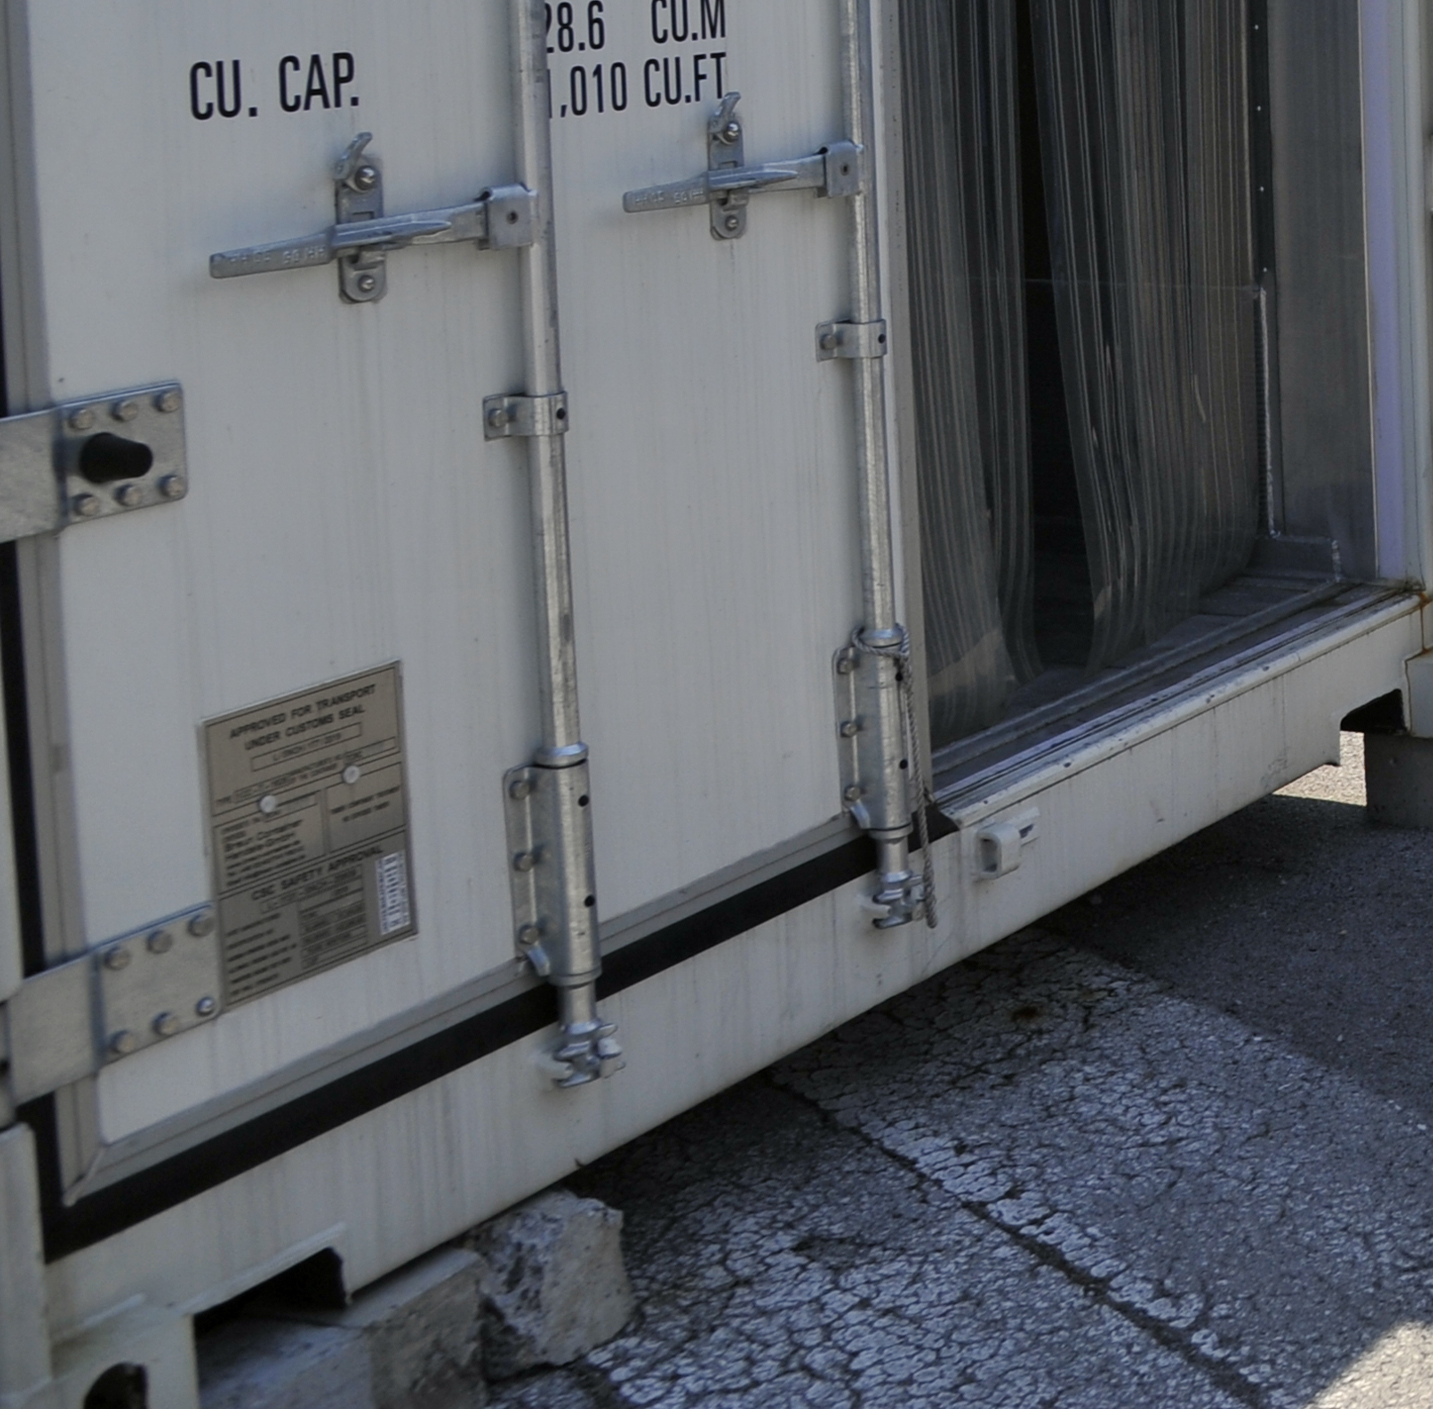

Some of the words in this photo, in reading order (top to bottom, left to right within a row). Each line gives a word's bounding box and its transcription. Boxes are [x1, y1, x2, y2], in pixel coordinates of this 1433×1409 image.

[189, 59, 258, 120] CU.
[278, 52, 360, 114] CAP.
[644, 52, 726, 107] CU.FT
[229, 711, 286, 739] APPROVED
[291, 701, 312, 718] FOR
[315, 683, 376, 711] TRANSPORT
[244, 732, 282, 751] UNDER
[285, 714, 334, 738] CUSTOMS
[338, 704, 366, 722] SEAL
[251, 884, 276, 901] CSC
[280, 865, 323, 890] SAFETY
[328, 844, 384, 872] APPROVAL
